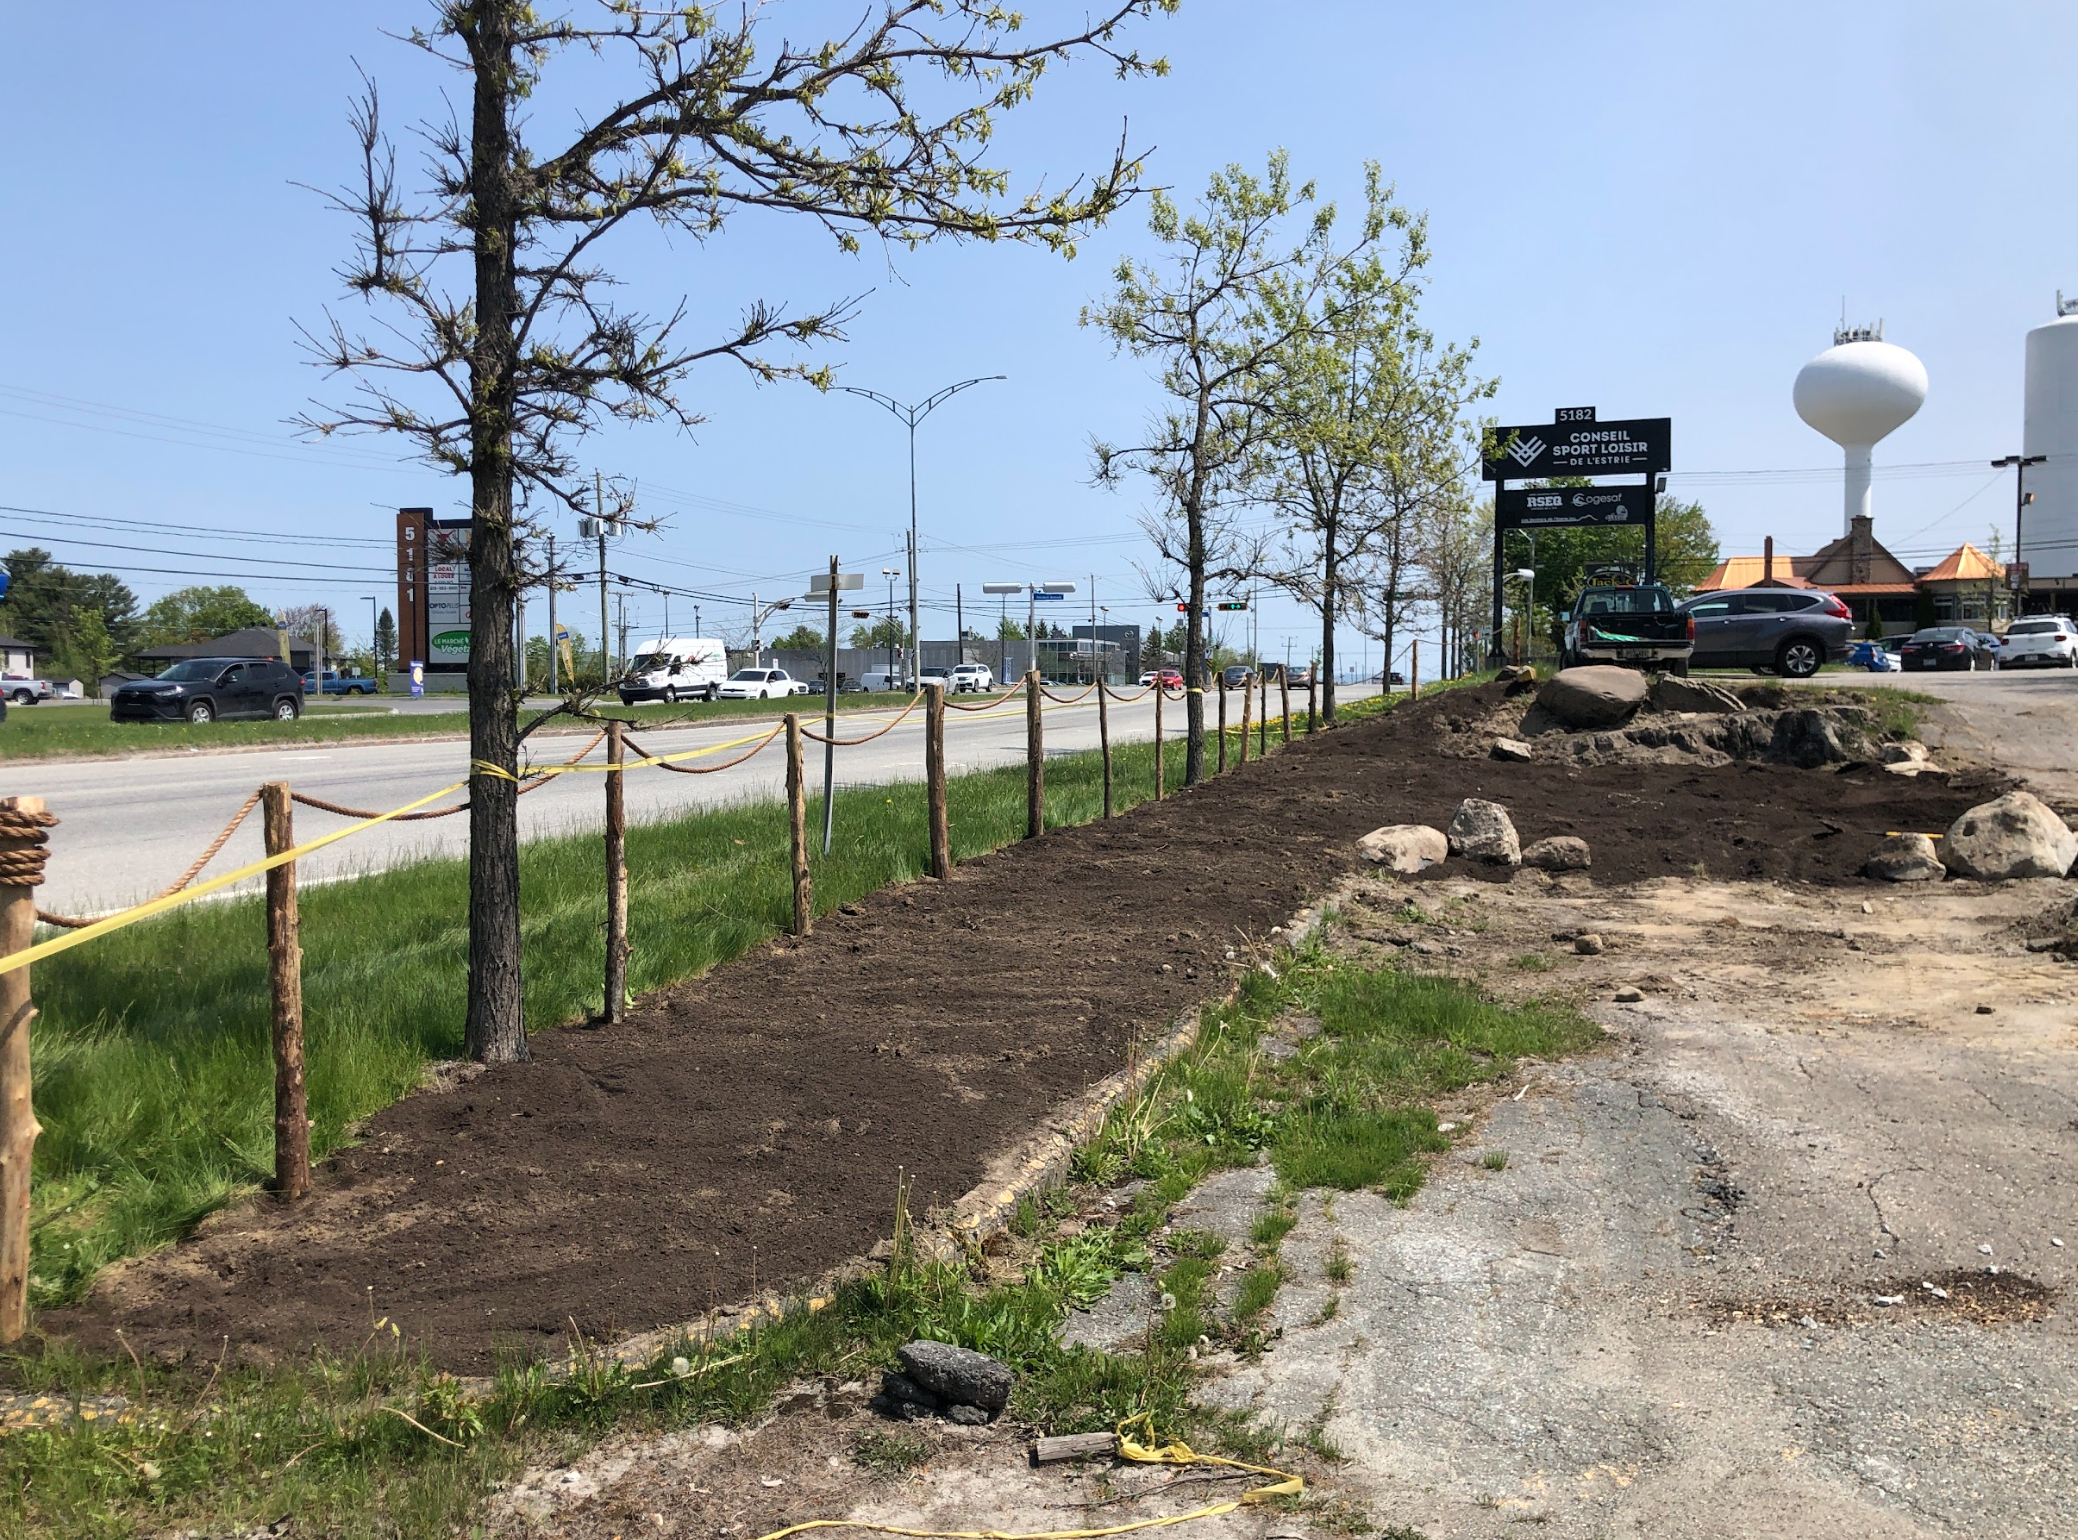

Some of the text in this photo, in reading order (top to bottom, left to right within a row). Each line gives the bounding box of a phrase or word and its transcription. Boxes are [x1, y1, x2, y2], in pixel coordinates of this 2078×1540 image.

[1560, 409, 1592, 421] 5182
[1570, 430, 1630, 443] CONSEIL
[1553, 442, 1648, 456] SPORT LOISIR
[1587, 455, 1630, 465] L'ESTRIE
[1526, 496, 1563, 507] RSEQ
[441, 644, 471, 654] Végéta
